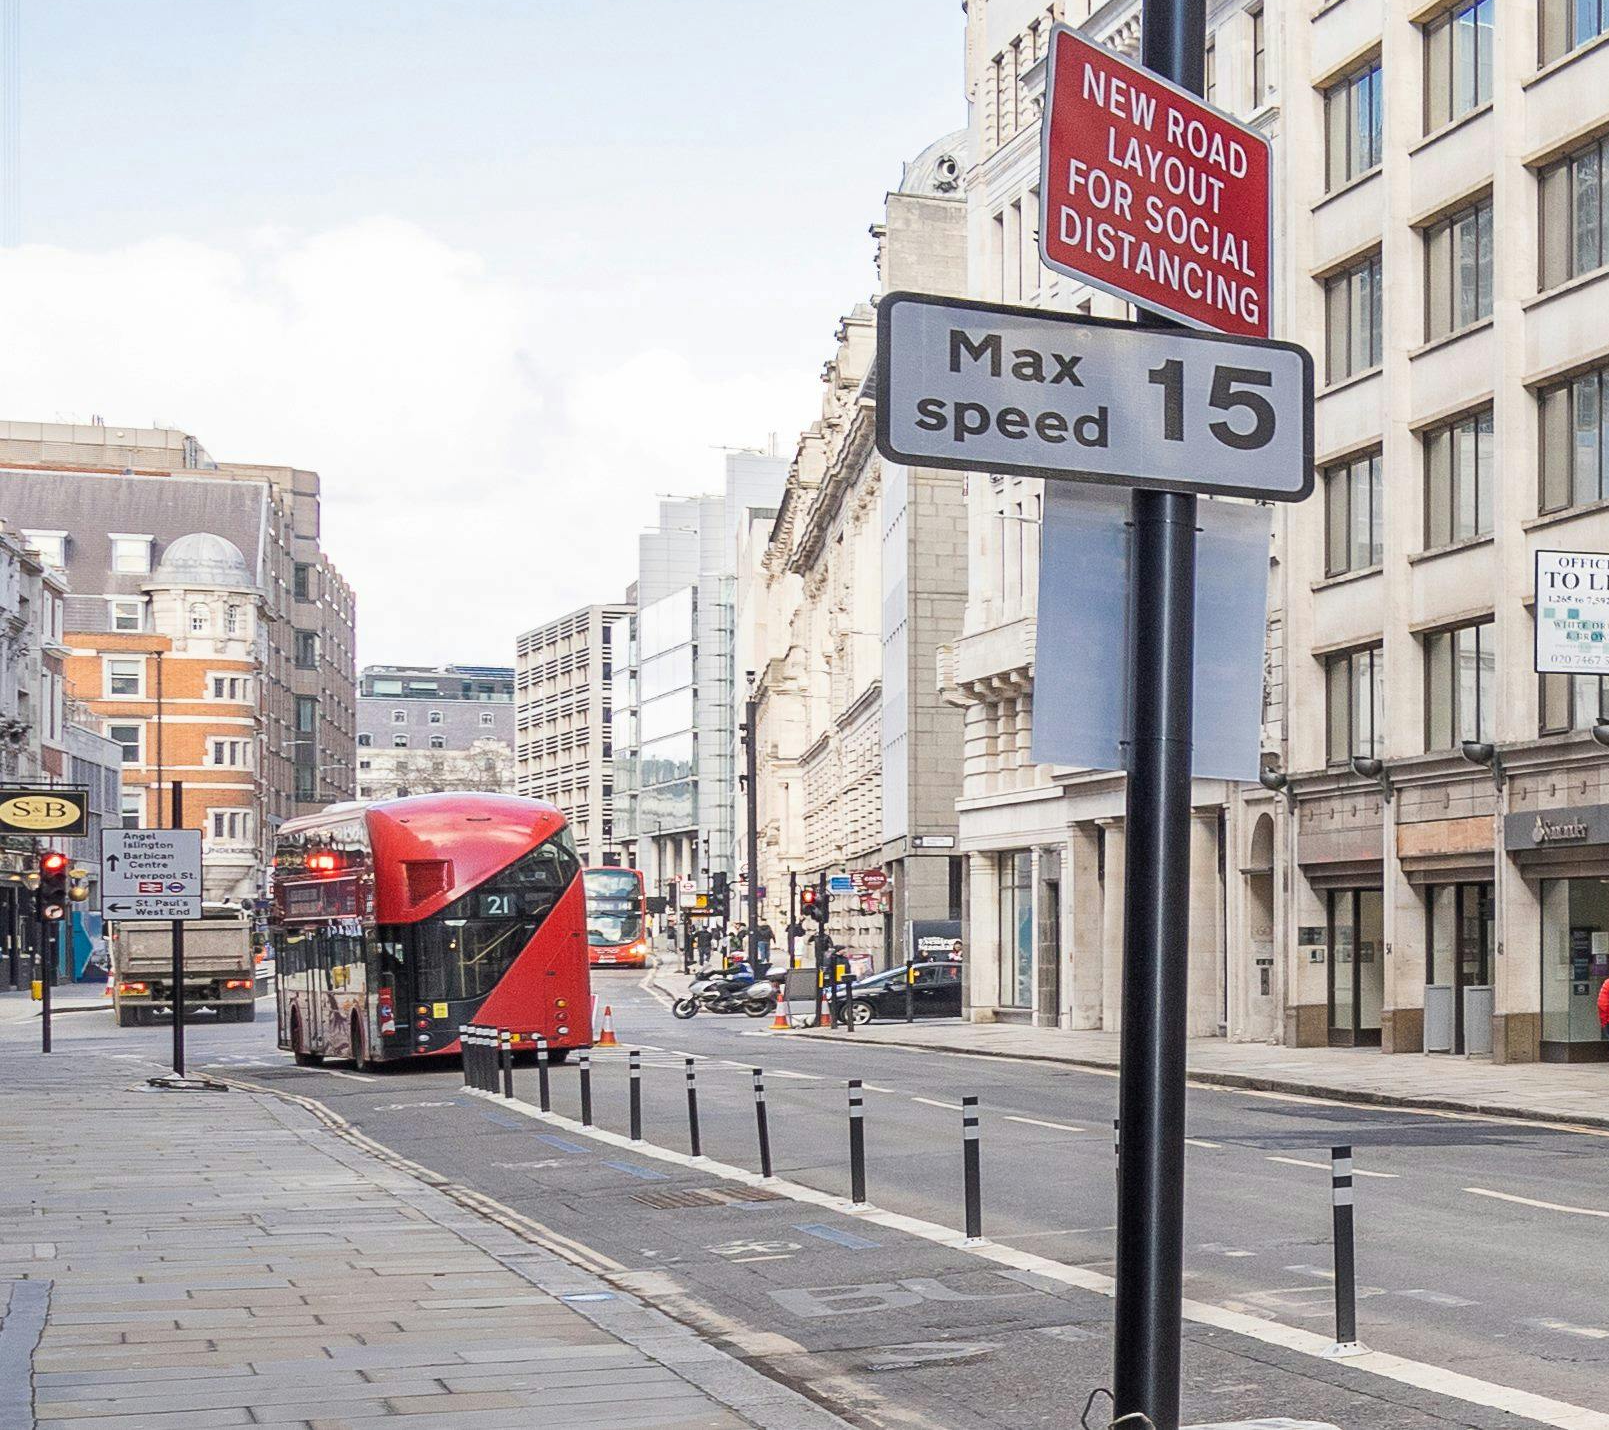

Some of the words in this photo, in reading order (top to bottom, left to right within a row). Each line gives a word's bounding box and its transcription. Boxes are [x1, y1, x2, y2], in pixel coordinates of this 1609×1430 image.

[1083, 63, 1156, 131] NEW
[1167, 107, 1248, 179] ROAD
[1108, 126, 1225, 214] LAYOUT
[1068, 158, 1133, 221] FOR
[1145, 196, 1256, 277] SOCIAL
[1060, 205, 1259, 325] DISTANCING
[950, 329, 1085, 387] Max
[1148, 358, 1277, 451] 15
[915, 396, 1110, 448] speed
[1545, 571, 1580, 590] TO
[1551, 654, 1571, 663] 020
[123, 832, 156, 841] Angel
[123, 841, 173, 850] Islington
[123, 852, 175, 860] Barbican
[129, 861, 168, 869] Centre
[123, 872, 177, 881] Liverpool
[181, 872, 197, 880] St.
[136, 908, 164, 916] West
[169, 908, 190, 916] End
[156, 899, 189, 907] Paul's
[487, 896, 509, 914] 21
